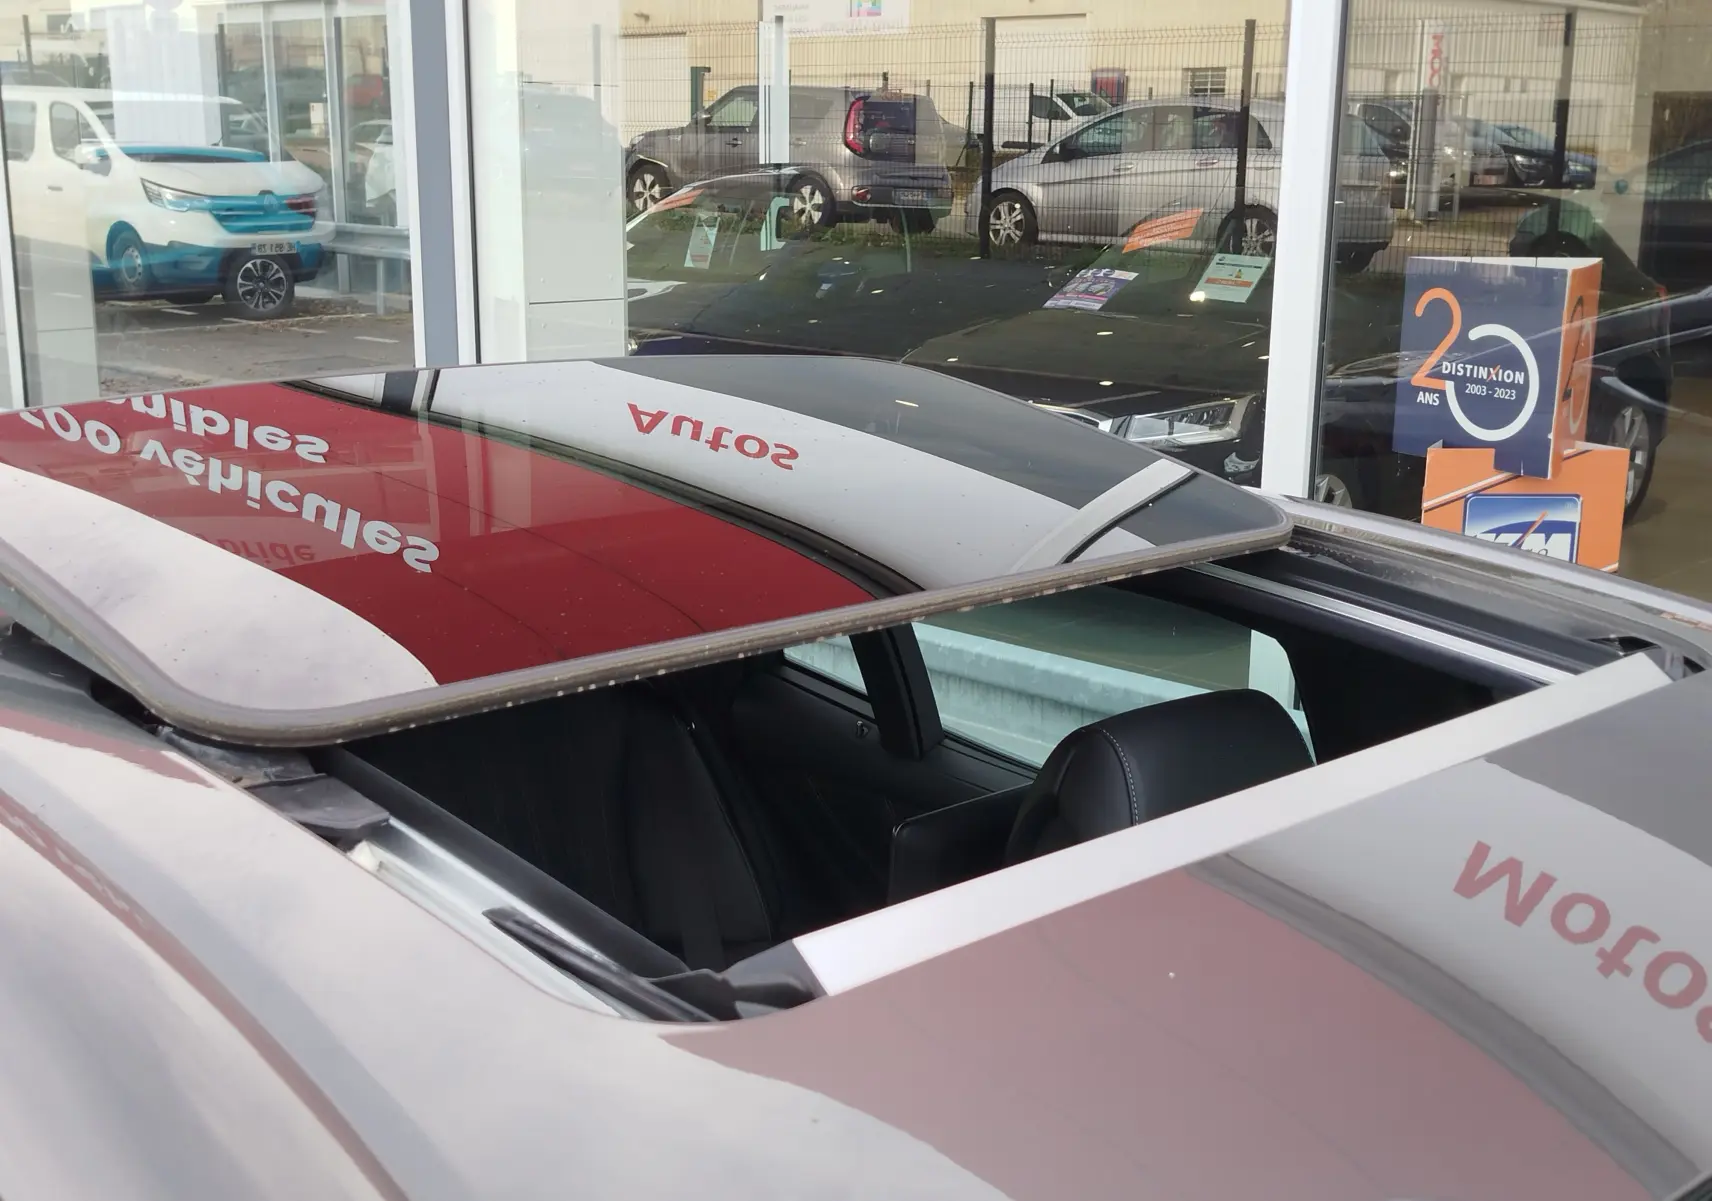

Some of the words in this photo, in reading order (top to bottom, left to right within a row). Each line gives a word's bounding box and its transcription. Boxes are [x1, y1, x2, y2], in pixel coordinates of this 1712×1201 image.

[1442, 361, 1525, 384] DISTINXION
[1416, 391, 1440, 406] ANS
[1465, 383, 1487, 396] 2003
[1493, 387, 1517, 400] 2023
